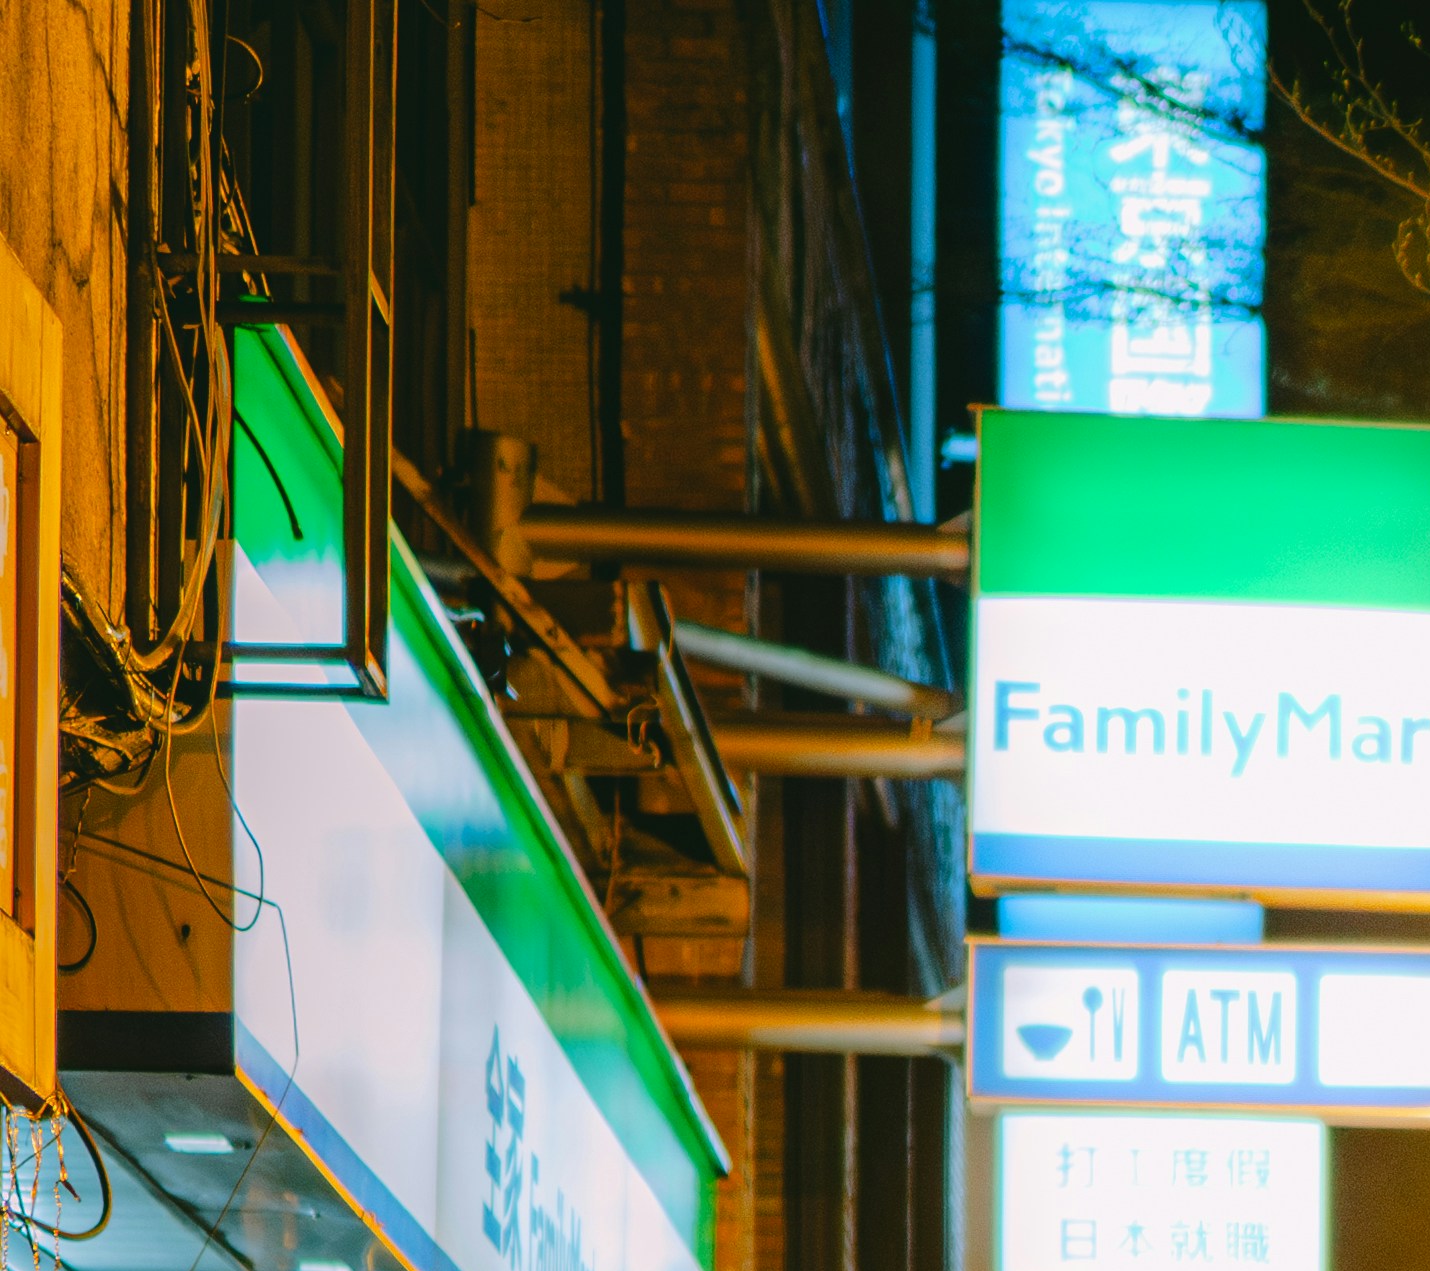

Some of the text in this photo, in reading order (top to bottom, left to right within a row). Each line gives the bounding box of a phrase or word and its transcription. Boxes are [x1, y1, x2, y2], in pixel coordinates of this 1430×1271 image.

[1177, 986, 1283, 1067] ATM
[1056, 1143, 1271, 1188] 打工度假
[1060, 1217, 1270, 1264] 日本就職
